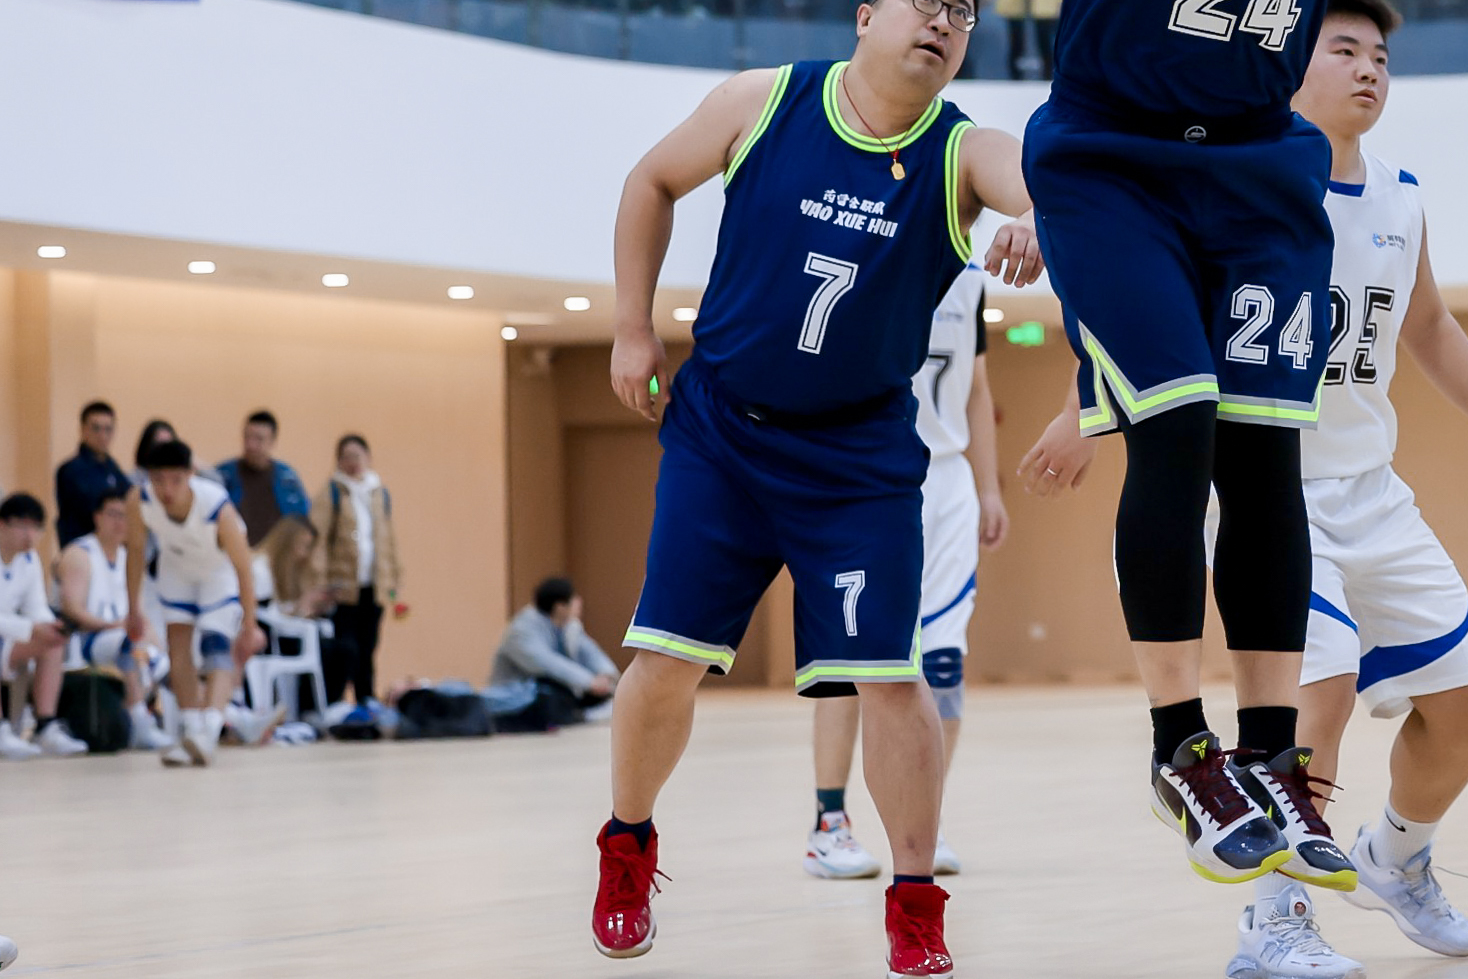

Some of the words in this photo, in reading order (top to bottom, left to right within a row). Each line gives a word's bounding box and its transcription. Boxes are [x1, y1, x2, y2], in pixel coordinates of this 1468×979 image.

[833, 210, 868, 231] XUE
[867, 218, 898, 238] HUI
[797, 252, 859, 354] 7
[1225, 284, 1313, 370] 24
[1323, 285, 1395, 385] 25
[834, 570, 866, 637] 7
